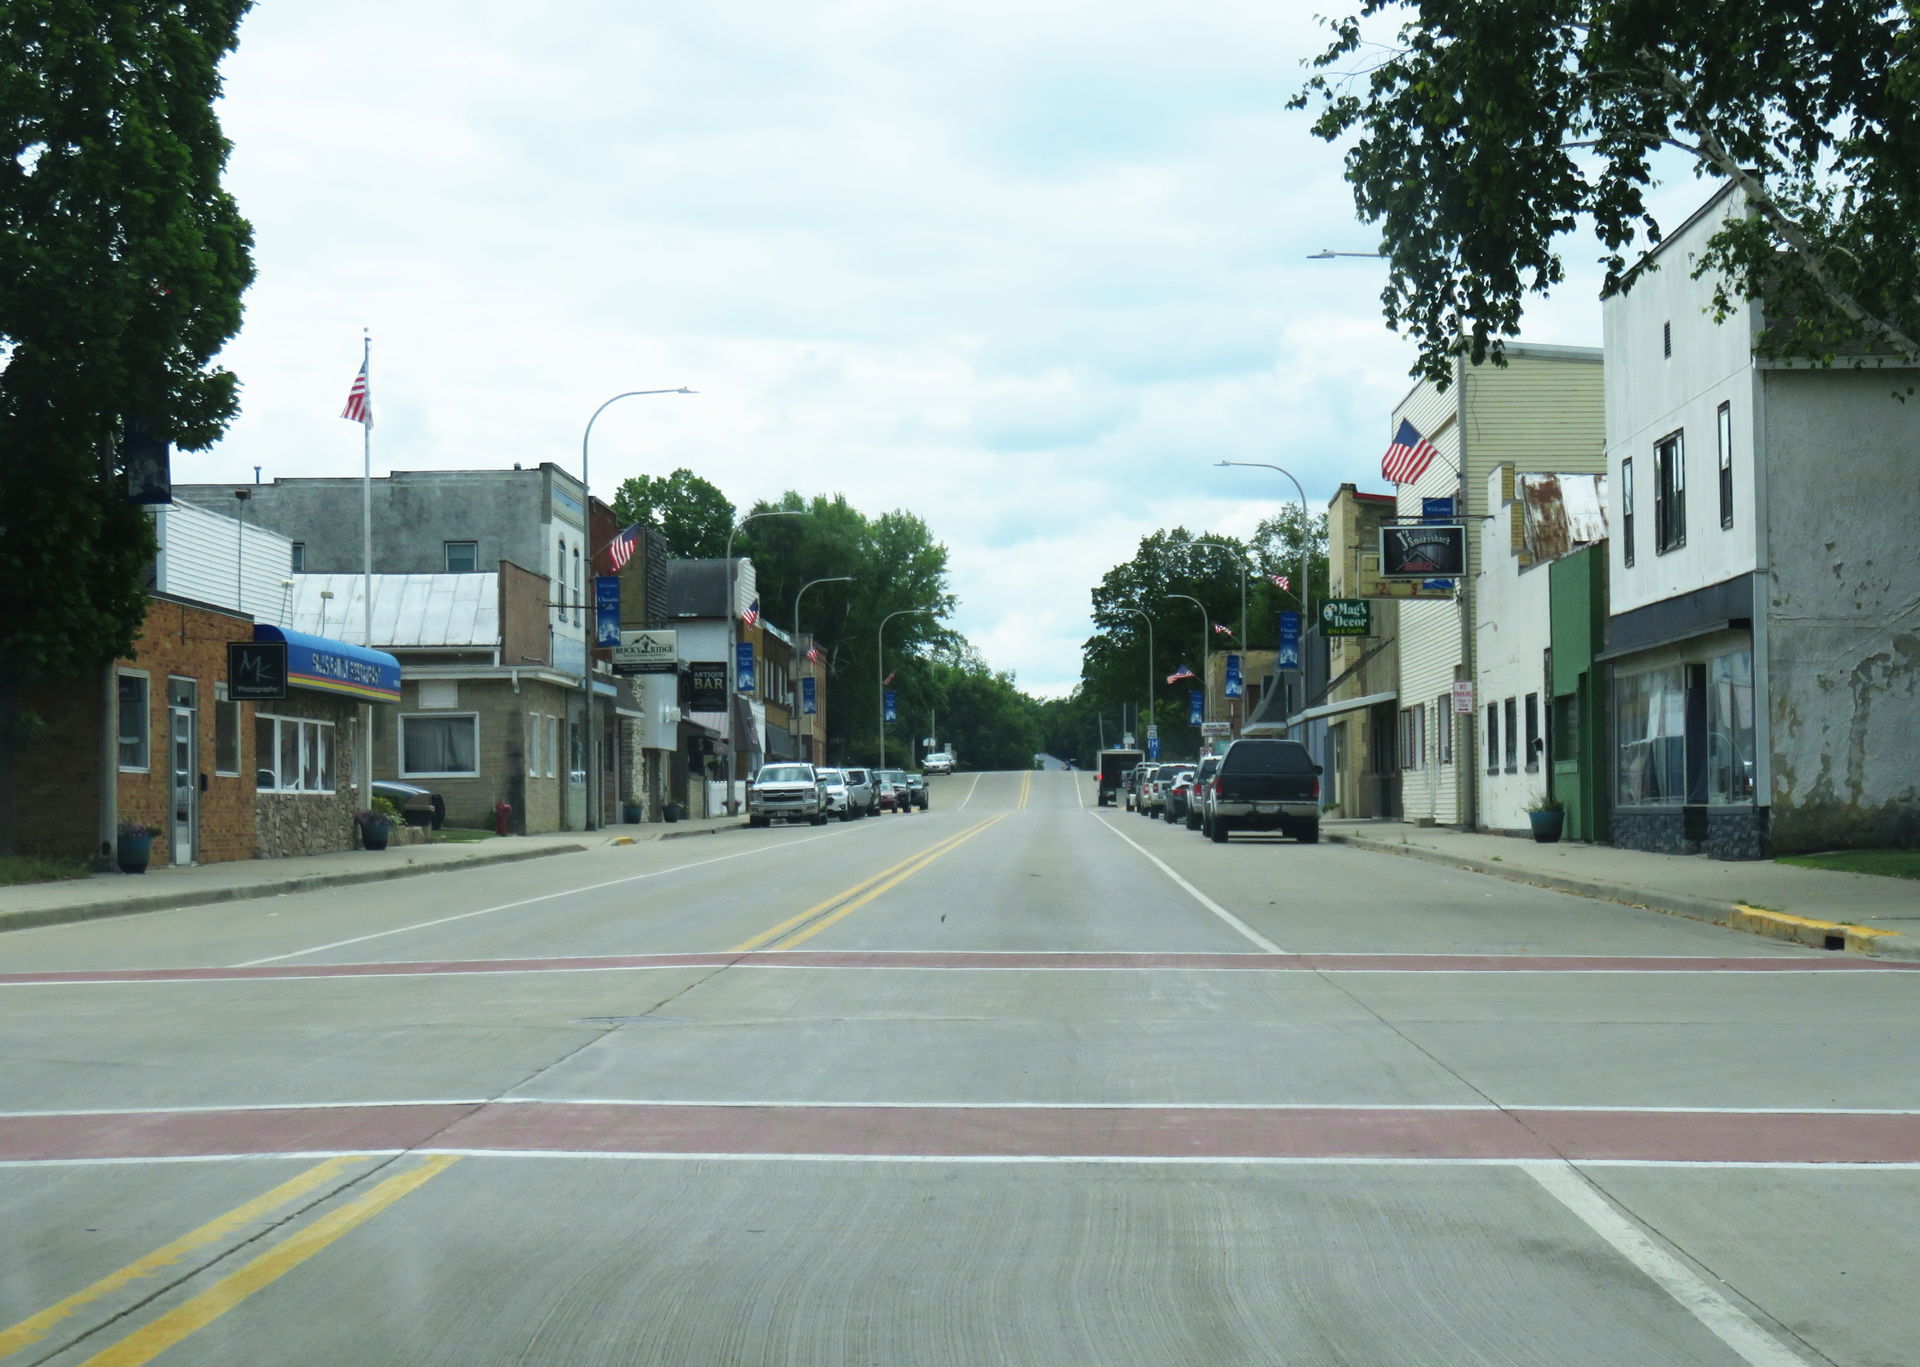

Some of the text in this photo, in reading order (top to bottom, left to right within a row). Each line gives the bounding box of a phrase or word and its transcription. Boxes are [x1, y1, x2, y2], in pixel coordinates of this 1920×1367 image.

[1338, 602, 1367, 616] Mag's
[1335, 615, 1367, 627] Decor
[615, 645, 675, 654] ROCKY RIDGE
[350, 660, 381, 686] RESTAURANT
[693, 678, 724, 690] BAR
